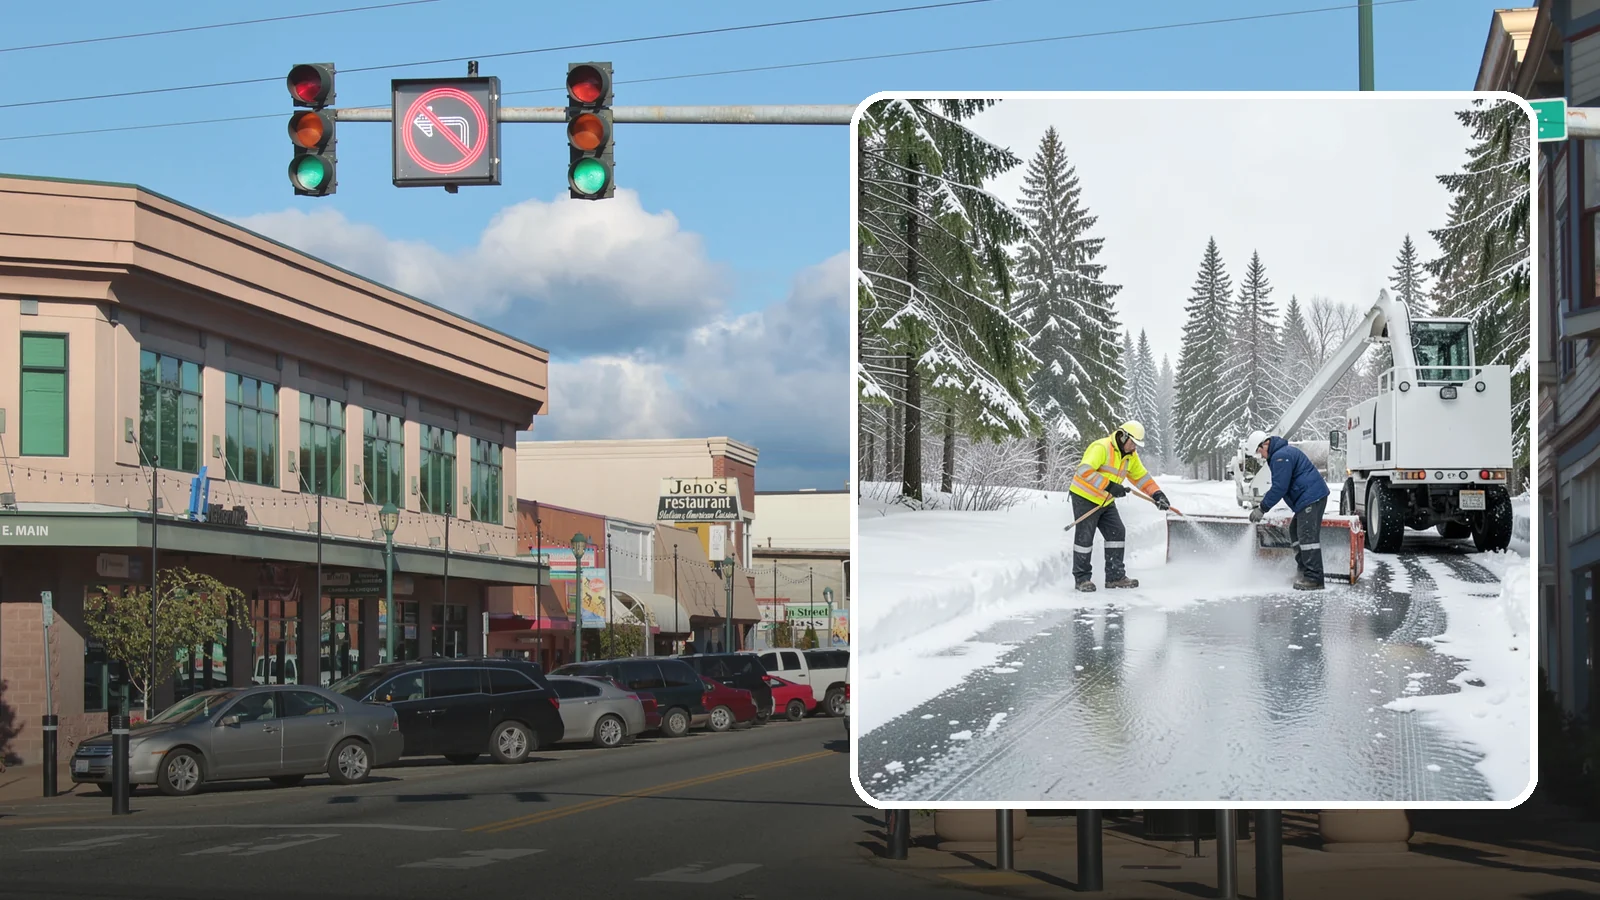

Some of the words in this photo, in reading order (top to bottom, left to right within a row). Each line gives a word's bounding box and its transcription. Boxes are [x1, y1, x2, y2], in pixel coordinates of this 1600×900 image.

[670, 480, 727, 494] Jeno's
[665, 496, 731, 509] restaurant
[659, 510, 682, 519] Italian
[686, 510, 714, 519] American
[715, 509, 737, 519] Cuisine
[2, 525, 13, 536] E.
[15, 525, 49, 536] MAIN
[785, 608, 795, 617] in
[797, 608, 828, 616] Street
